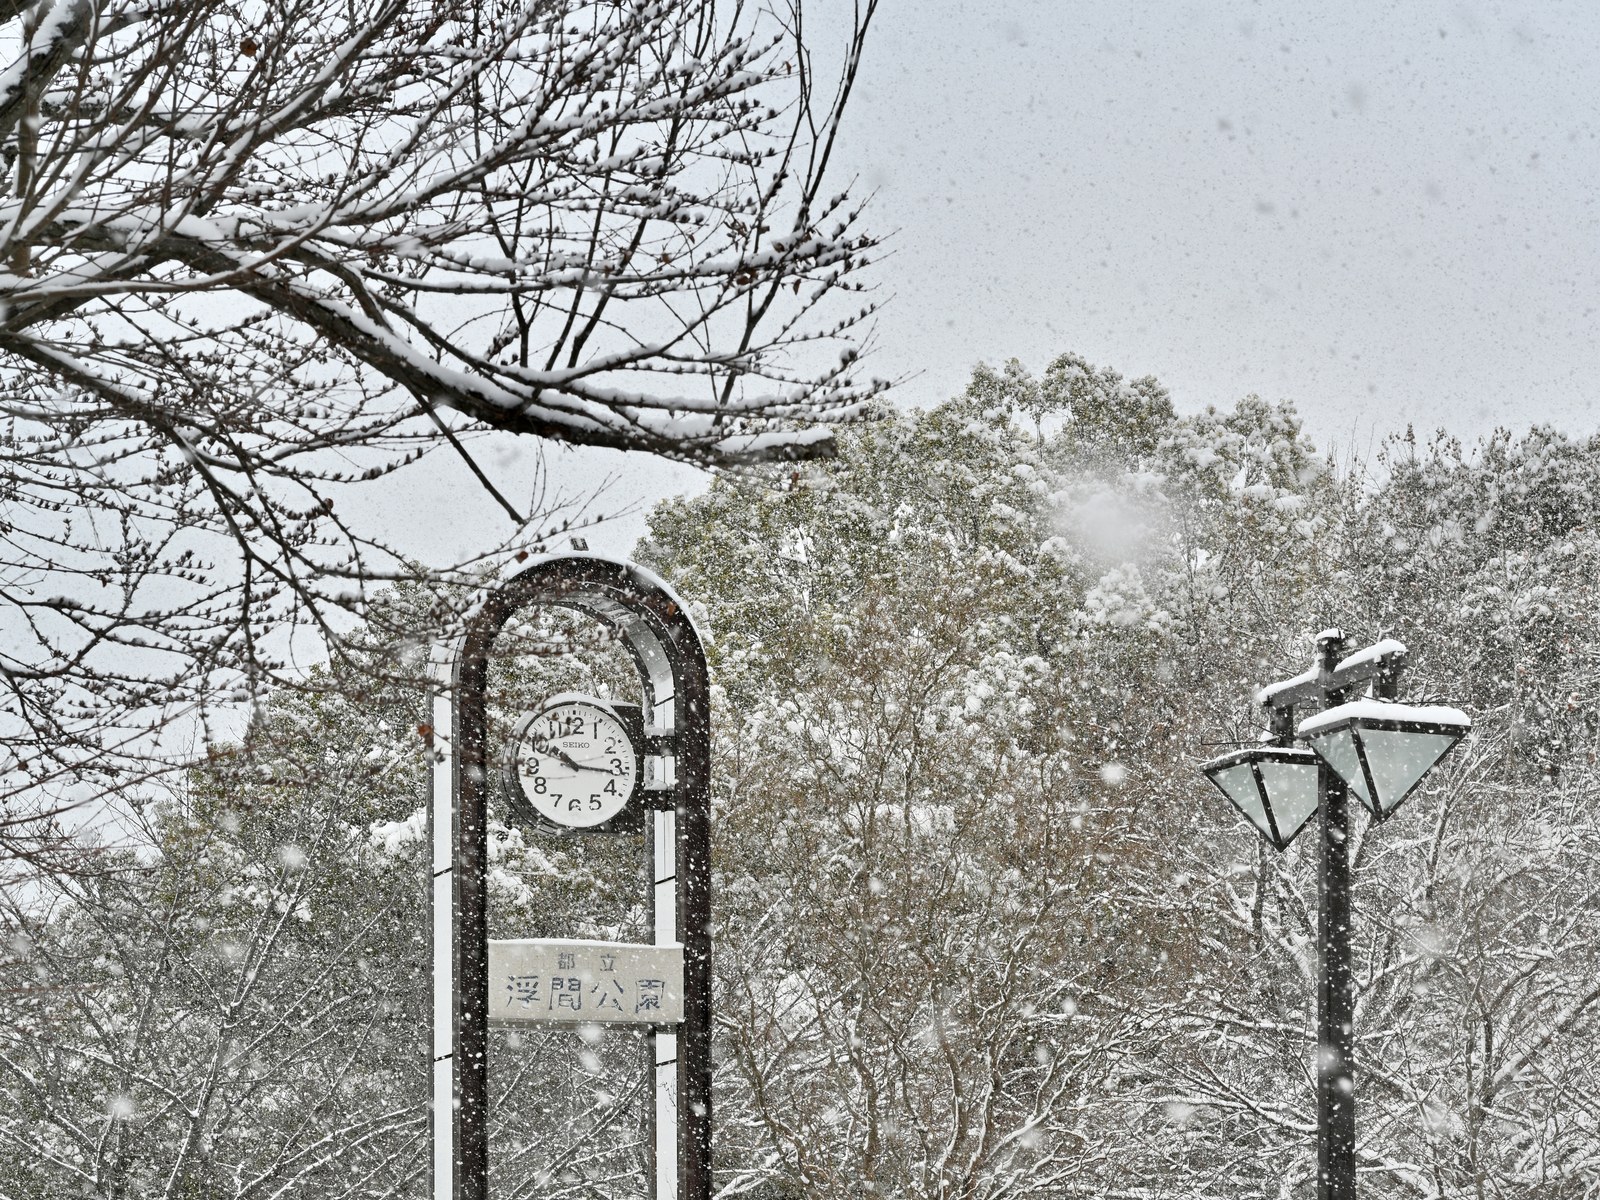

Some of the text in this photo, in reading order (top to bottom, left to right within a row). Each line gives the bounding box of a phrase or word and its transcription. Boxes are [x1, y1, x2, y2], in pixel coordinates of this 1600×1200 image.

[549, 720, 562, 738] 11
[594, 722, 597, 739] 1
[532, 734, 549, 754] 10
[604, 736, 616, 754] 2
[527, 757, 539, 775] 9
[610, 758, 622, 776] 3
[534, 776, 547, 794] 8
[603, 779, 617, 796] 4
[550, 794, 562, 808] 7
[568, 799, 582, 811] 6
[589, 794, 602, 811] 5
[558, 953, 616, 972] 都立
[506, 975, 665, 1014] 浮間公園
